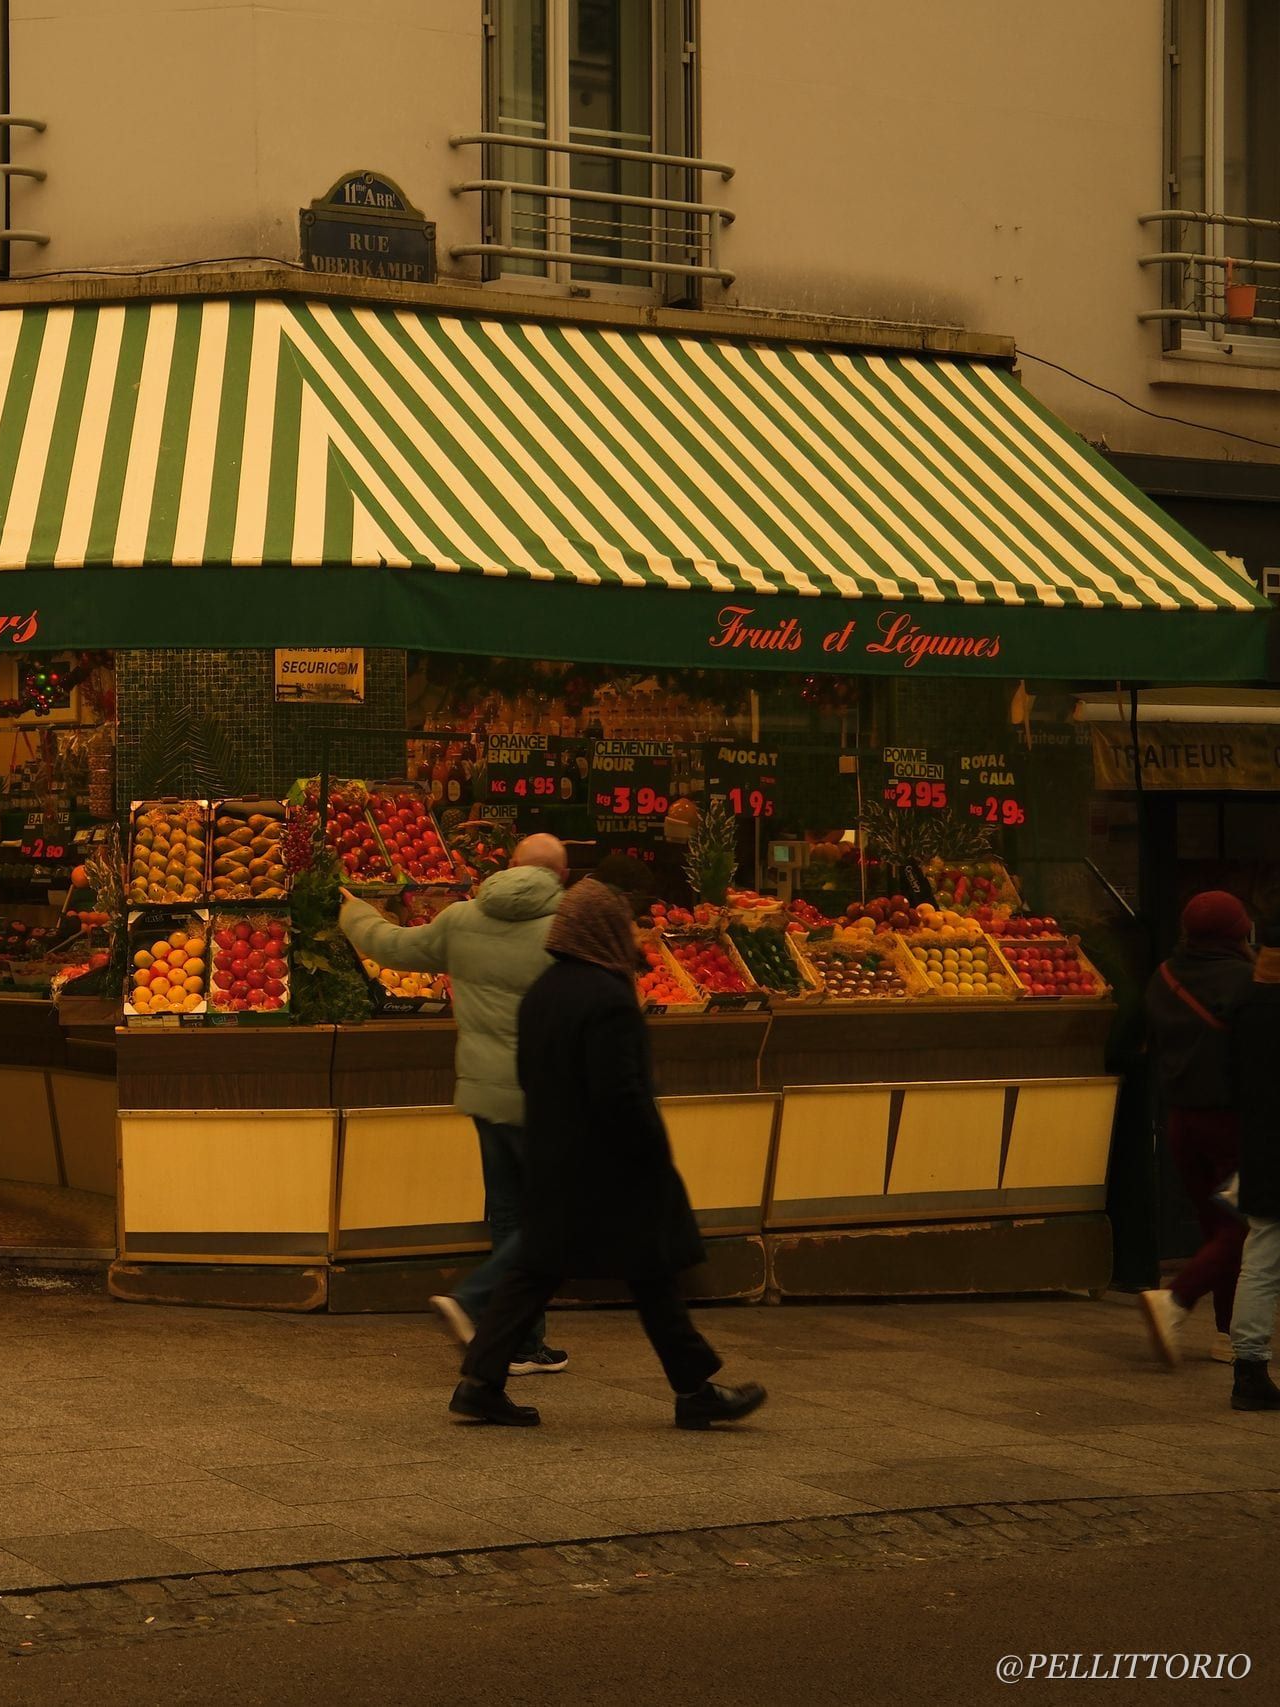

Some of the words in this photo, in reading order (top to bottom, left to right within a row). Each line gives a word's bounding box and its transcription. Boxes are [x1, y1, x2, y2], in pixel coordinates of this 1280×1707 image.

[348, 232, 390, 253] RUE
[312, 255, 425, 282] OBERKAMPF
[708, 604, 804, 652] Fruits
[822, 620, 857, 653] et
[866, 610, 1001, 669] Légumes
[282, 661, 359, 675] SECURICOM
[490, 734, 548, 750] ORANGE
[595, 741, 674, 756] CLEMENTINE
[488, 750, 531, 764] BRUT
[718, 746, 778, 767] AVOCAT
[885, 749, 926, 762] POMME
[961, 753, 1006, 770] ROYAL
[593, 757, 635, 772] NOUR
[896, 763, 943, 778] GOLDEN
[979, 771, 1015, 786] GALA
[491, 780, 507, 793] KG
[482, 805, 517, 818] POIRE
